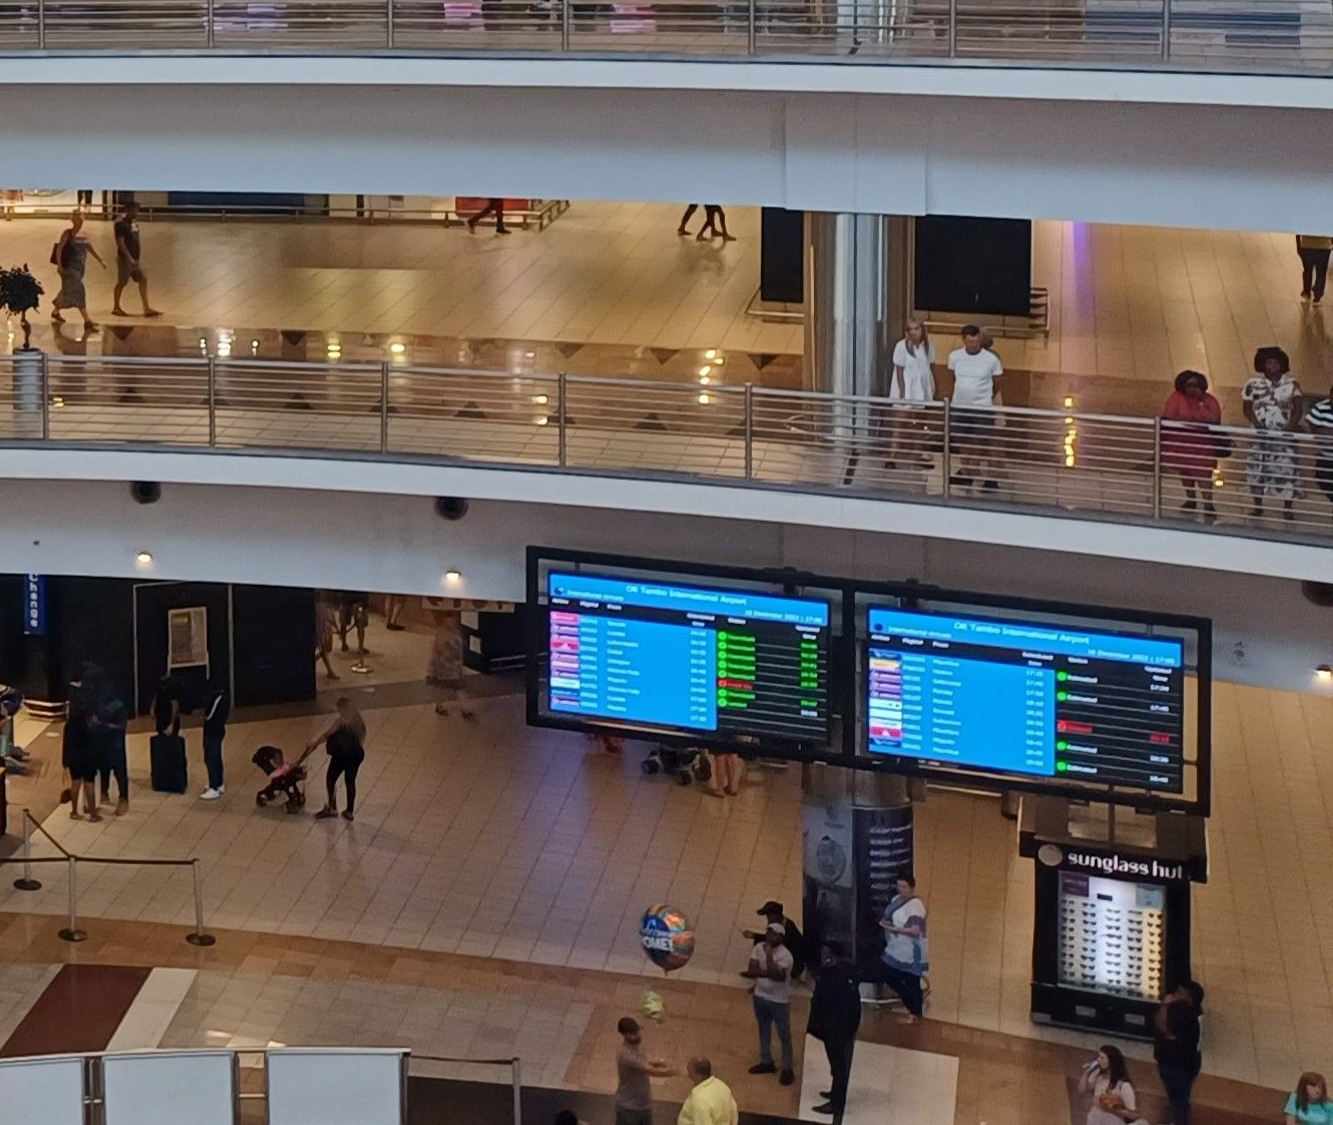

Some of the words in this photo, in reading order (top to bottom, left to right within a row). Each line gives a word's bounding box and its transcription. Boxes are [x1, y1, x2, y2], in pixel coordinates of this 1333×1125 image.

[954, 622, 967, 630] OR
[970, 624, 1000, 634] Tambo
[1002, 627, 1057, 642] International
[1059, 633, 1090, 645] Airport
[1068, 853, 1149, 875] sunglass
[1152, 860, 1182, 879] hut
